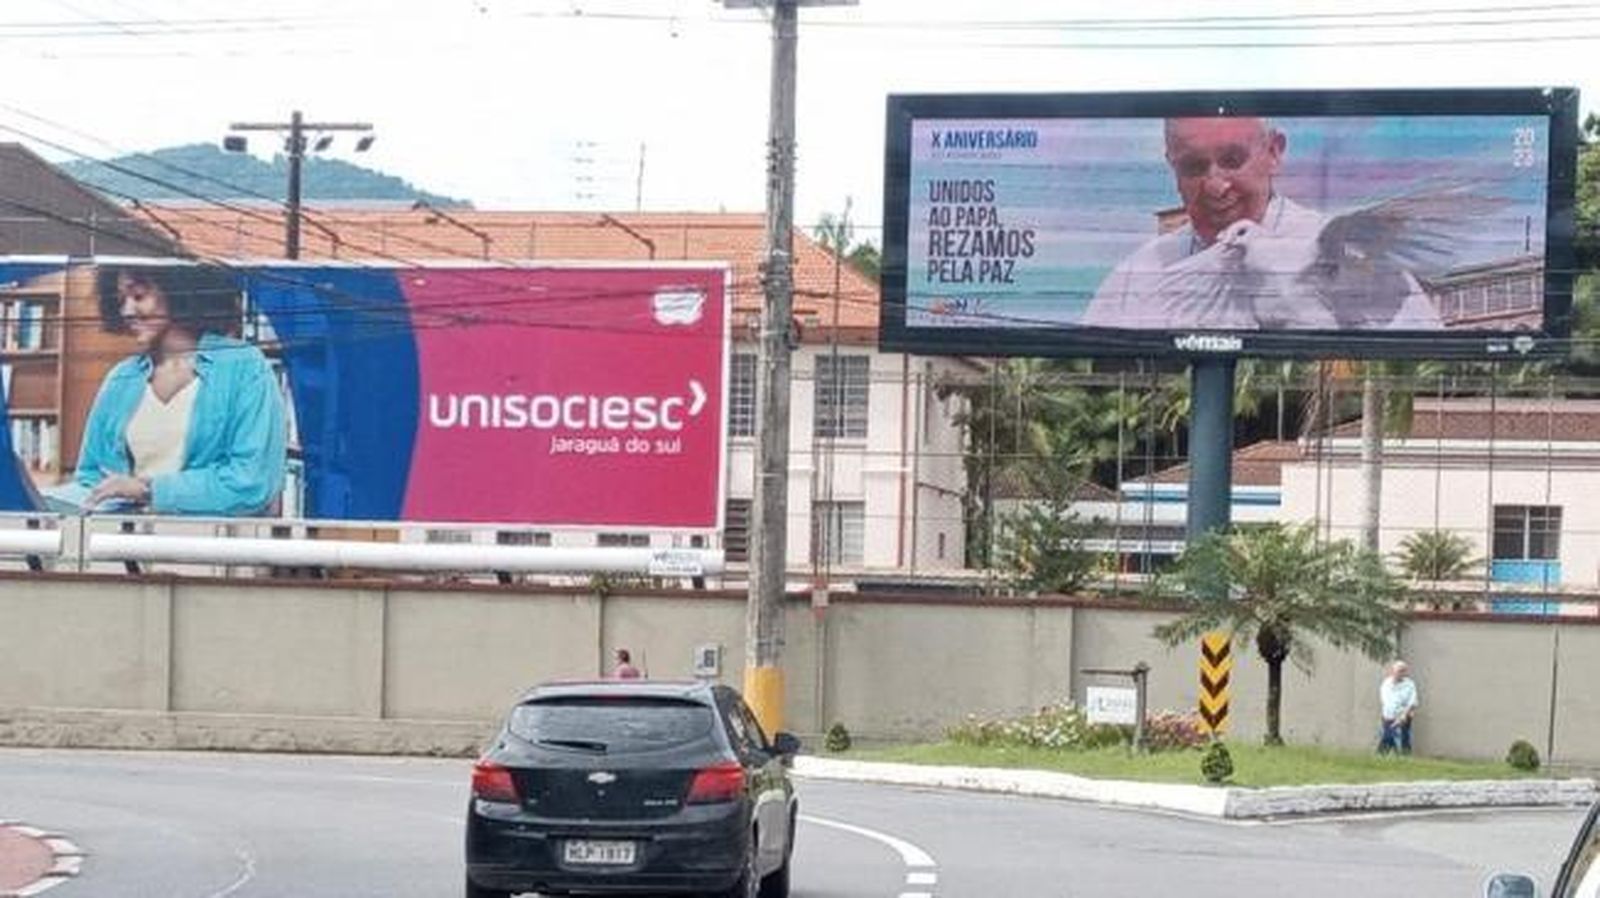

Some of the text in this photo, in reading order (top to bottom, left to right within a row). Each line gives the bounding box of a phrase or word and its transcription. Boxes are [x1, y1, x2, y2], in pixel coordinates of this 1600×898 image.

[931, 131, 941, 148] X
[929, 179, 996, 203] UNIDOS
[929, 206, 951, 227] AO
[928, 229, 1036, 258] REZAMOS
[927, 259, 1015, 284] PELA PAZ
[625, 436, 651, 453] do
[655, 436, 682, 453] sul
